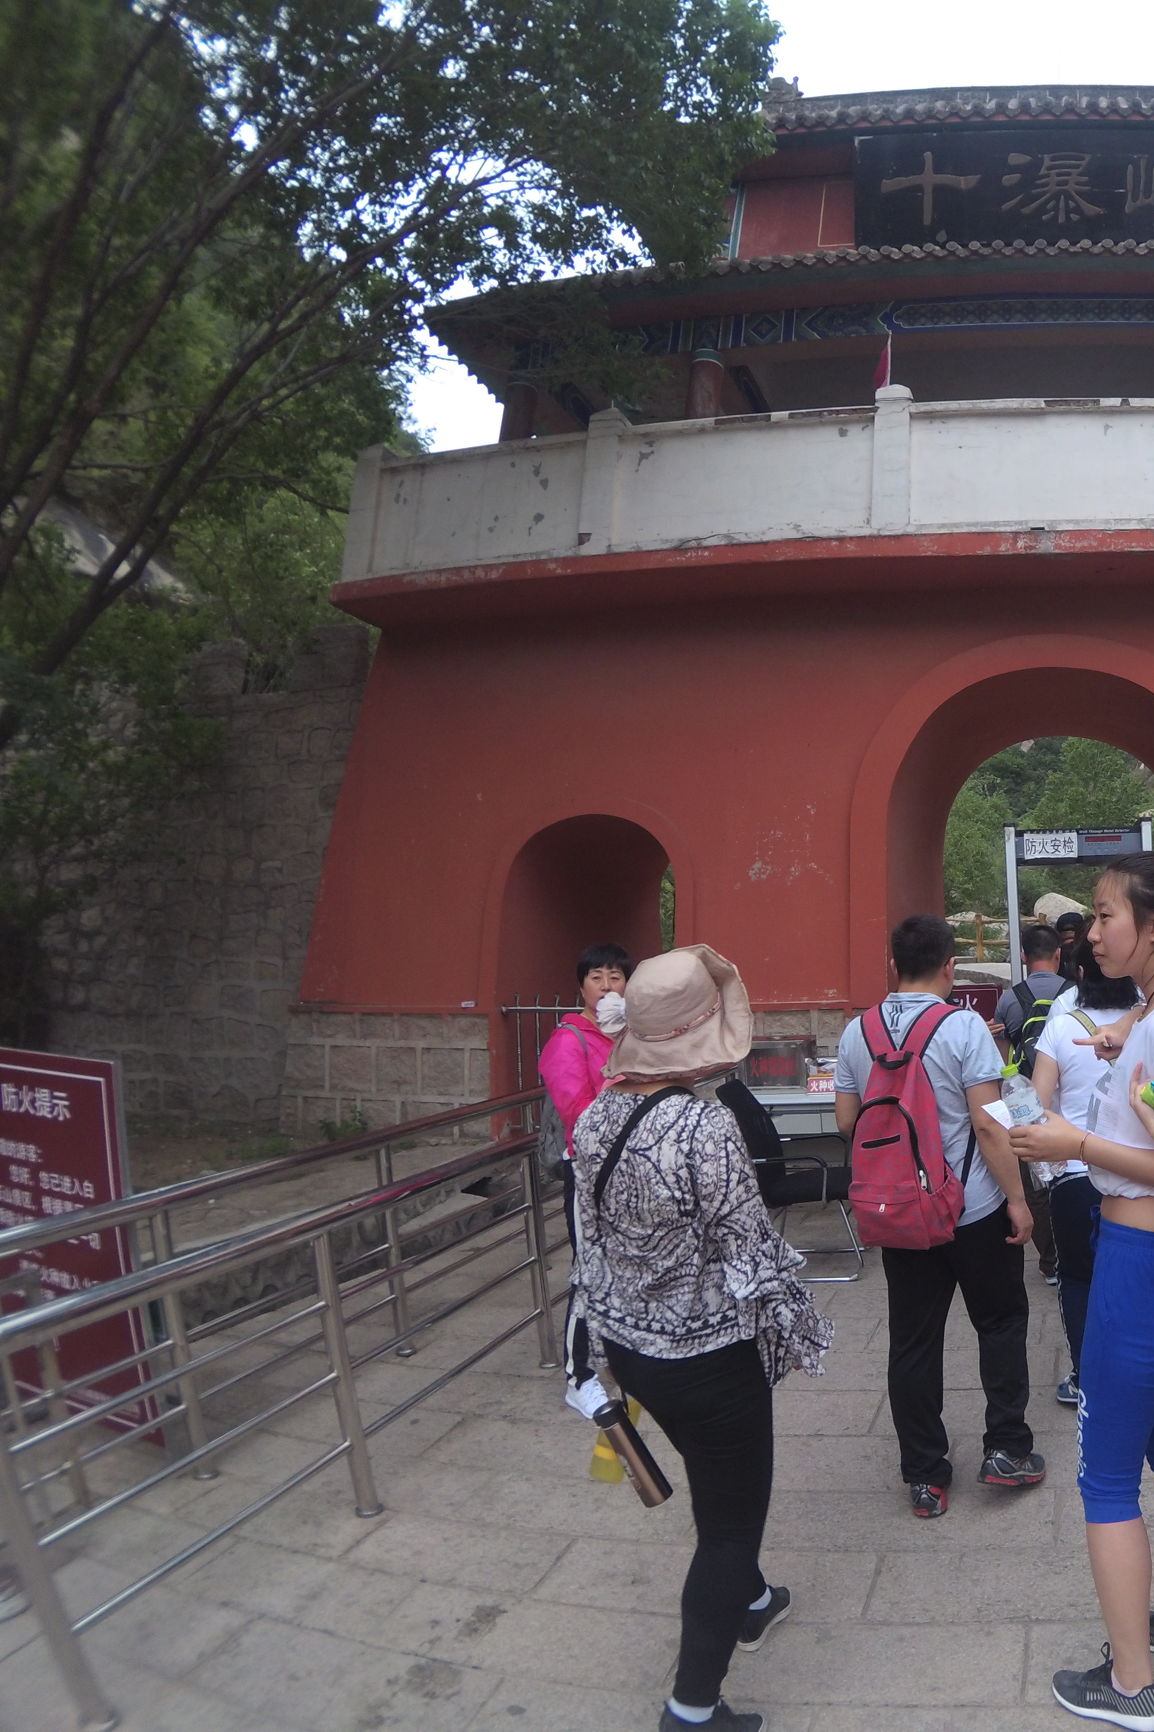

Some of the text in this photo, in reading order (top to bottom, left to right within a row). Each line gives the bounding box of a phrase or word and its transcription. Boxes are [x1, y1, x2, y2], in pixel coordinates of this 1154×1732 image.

[1025, 837, 1075, 856] 防火安检
[1, 1083, 71, 1121] 防火提示
